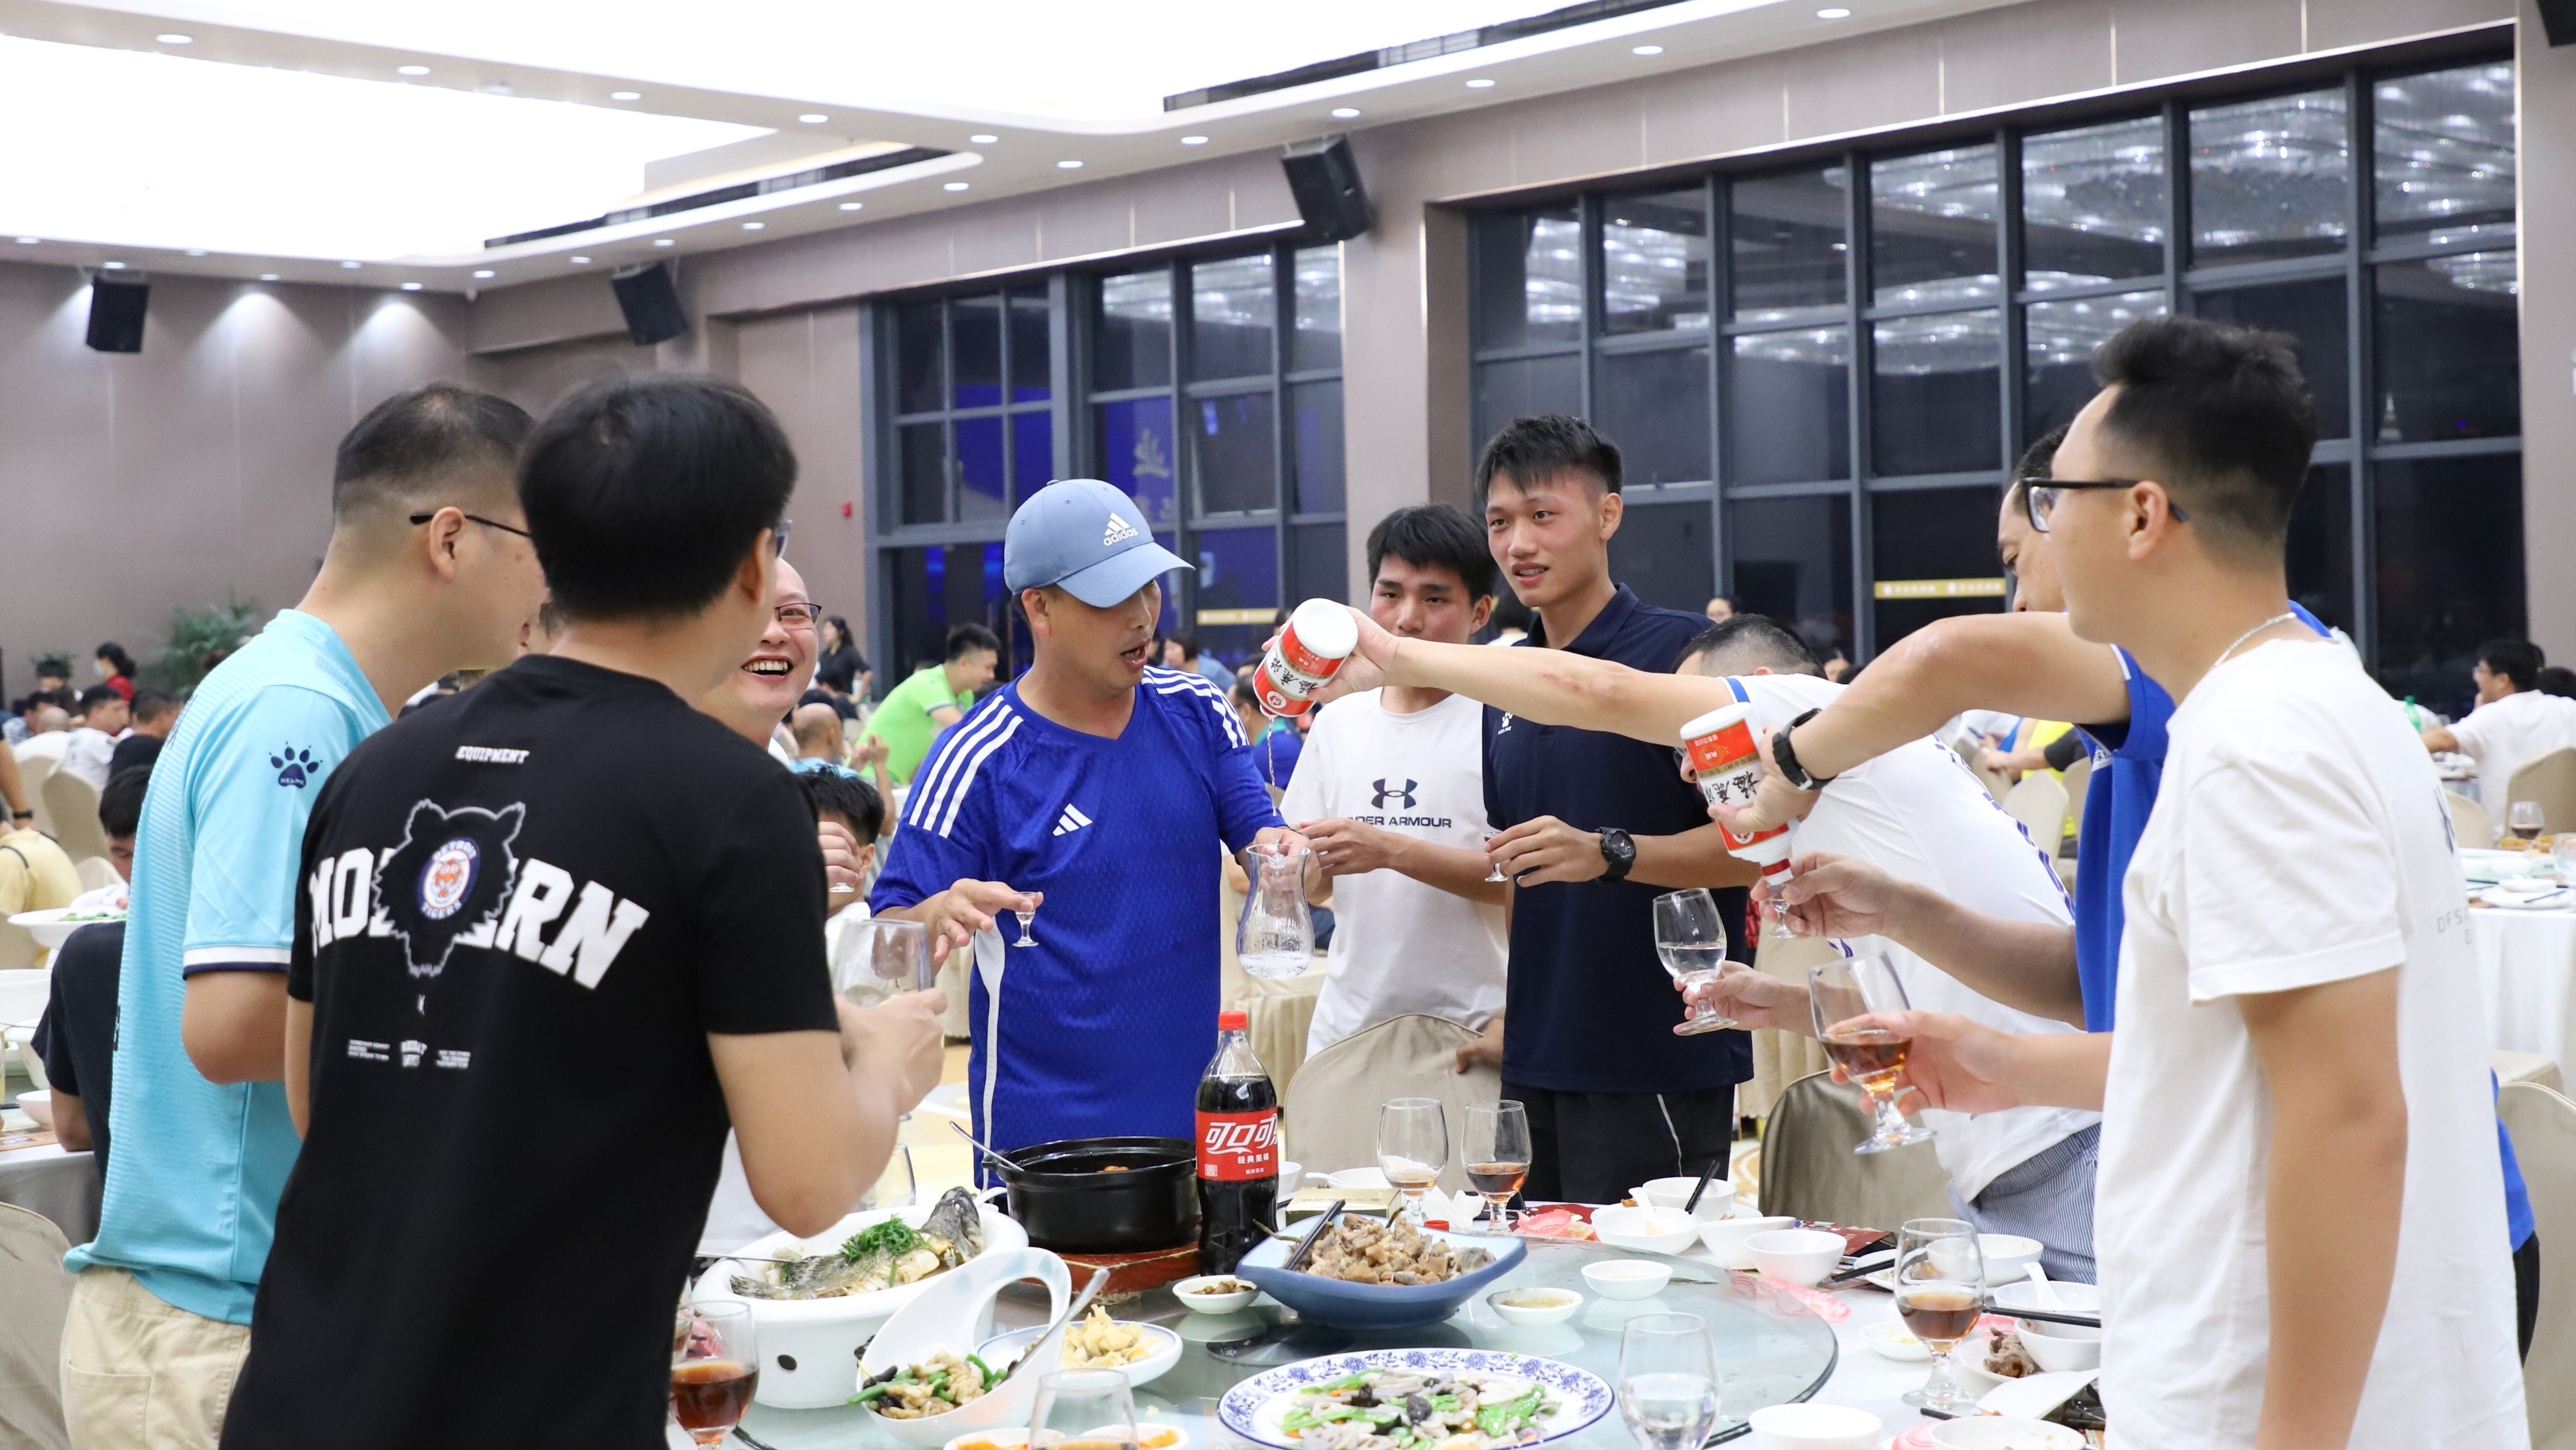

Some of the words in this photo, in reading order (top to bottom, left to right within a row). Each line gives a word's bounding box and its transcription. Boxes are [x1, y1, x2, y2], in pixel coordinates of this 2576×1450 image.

[1103, 528, 1138, 546] adidas
[455, 746, 530, 764] EQUIPMENT
[280, 777, 304, 785] KELME
[1389, 816, 1452, 828] ARMOUR
[432, 839, 477, 861] DETROIT
[420, 898, 463, 920] TIGERS
[1237, 1153, 1270, 1165] 经典美味
